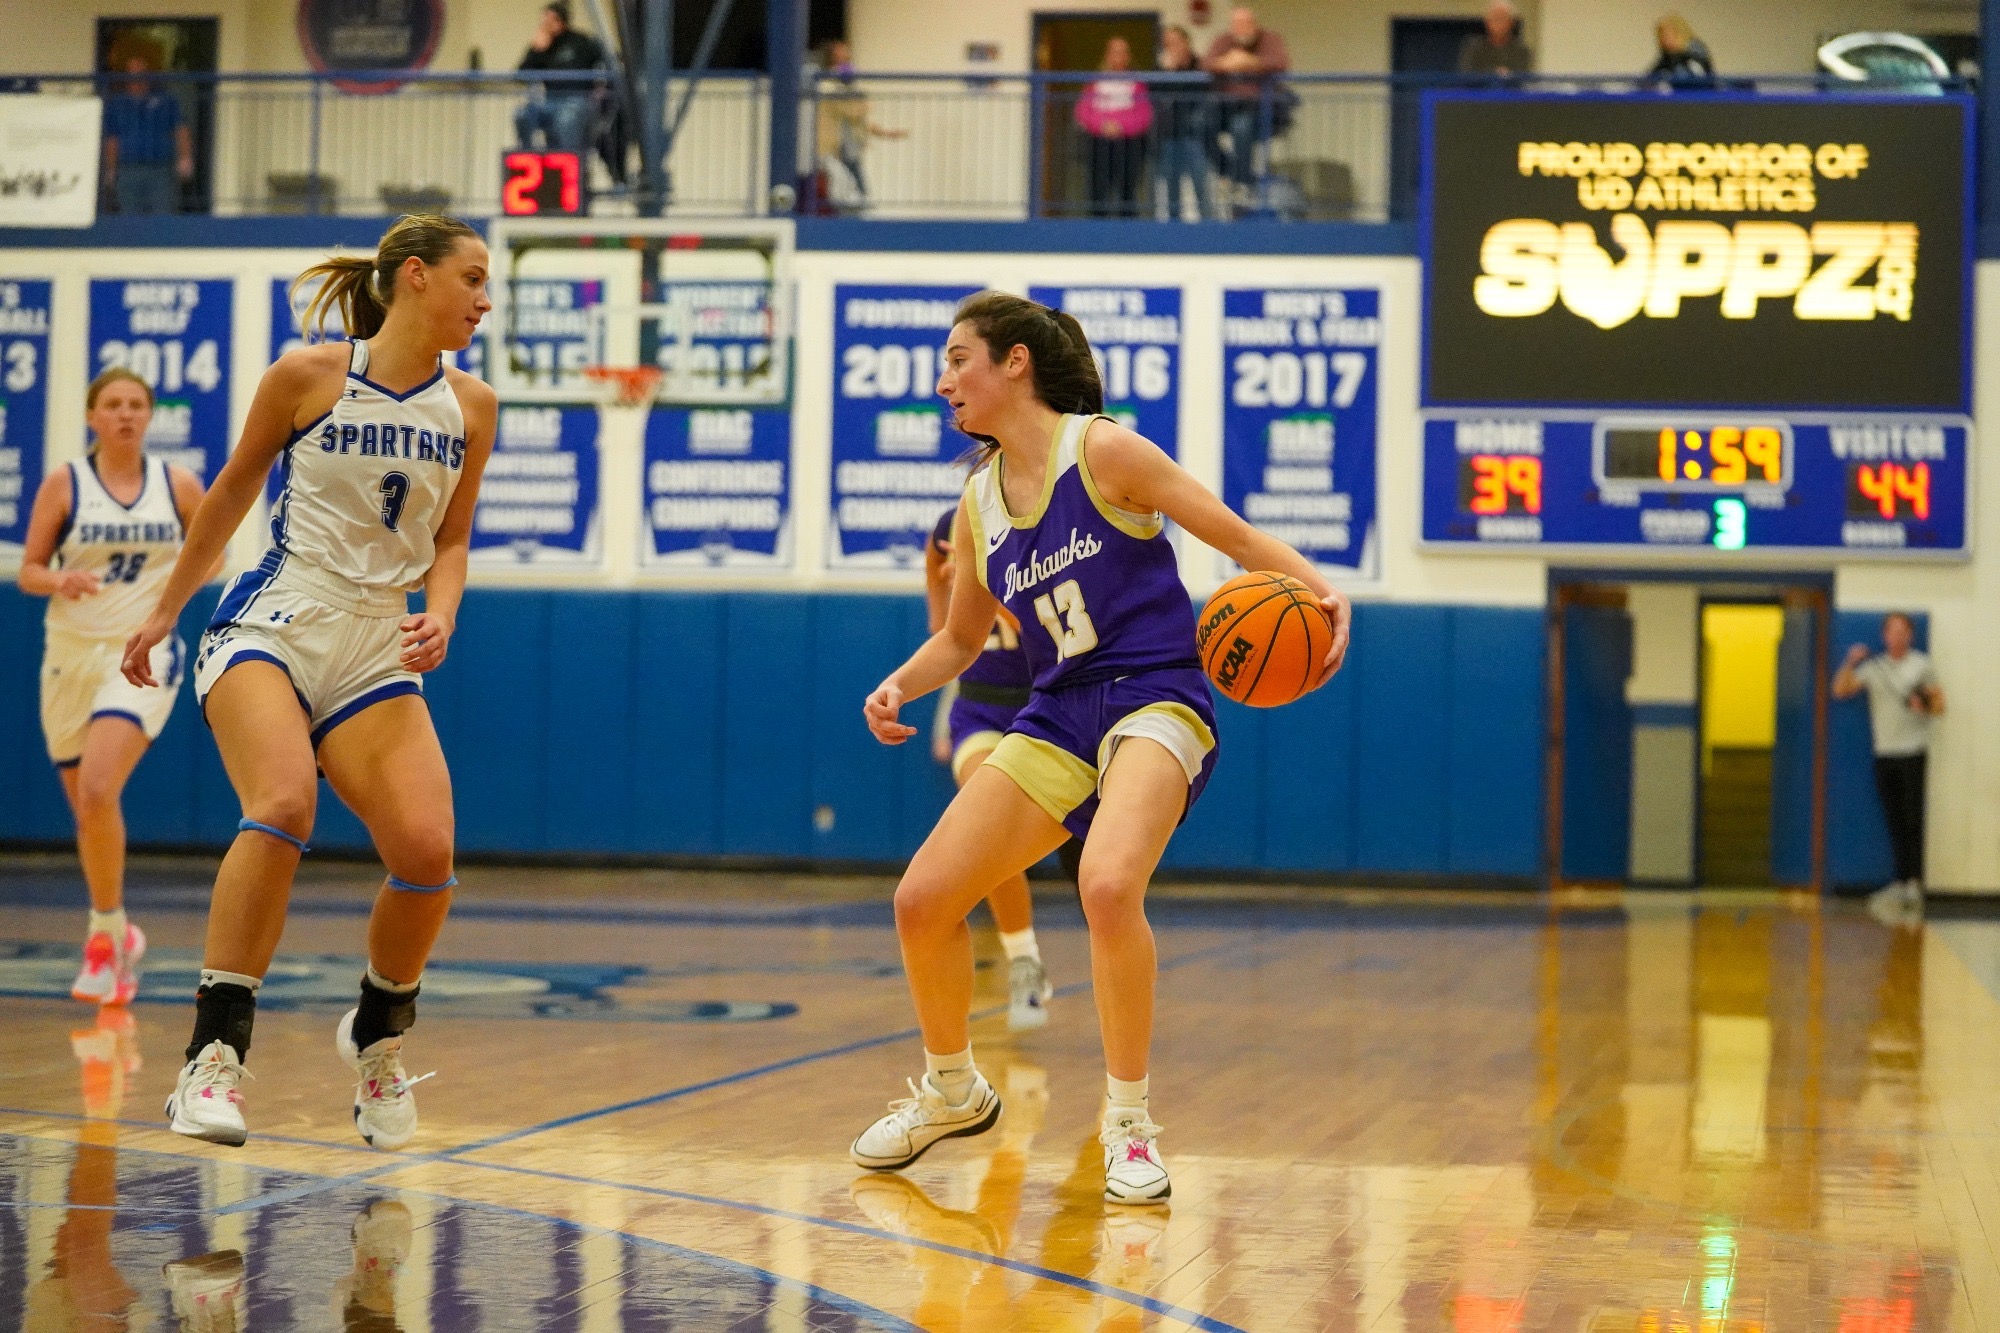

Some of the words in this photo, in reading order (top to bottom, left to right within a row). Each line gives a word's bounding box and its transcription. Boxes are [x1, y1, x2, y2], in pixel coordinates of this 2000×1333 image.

[503, 152, 580, 215] 27
[1518, 142, 1644, 177] PROUD
[1646, 142, 1812, 178] SPONSOR
[1815, 143, 1869, 179] OF
[1577, 177, 1633, 210] UD
[1634, 176, 1817, 211] ATHLETICS
[1474, 213, 1881, 328] SUPPZ
[99, 339, 222, 392] 2014
[842, 344, 948, 399] 201
[1101, 347, 1171, 400] 16
[1233, 351, 1369, 408] 2017
[320, 423, 466, 470] SPARTANS
[1659, 426, 1782, 484] 1:59
[1829, 426, 1946, 459] VISITOR
[379, 471, 411, 533] 3
[1471, 455, 1542, 514] 39
[1857, 462, 1930, 520] 44
[1713, 499, 1747, 550] 3
[1004, 527, 1102, 604] Duhawks
[1033, 579, 1098, 665] 13
[1216, 636, 1254, 692] NCAA
